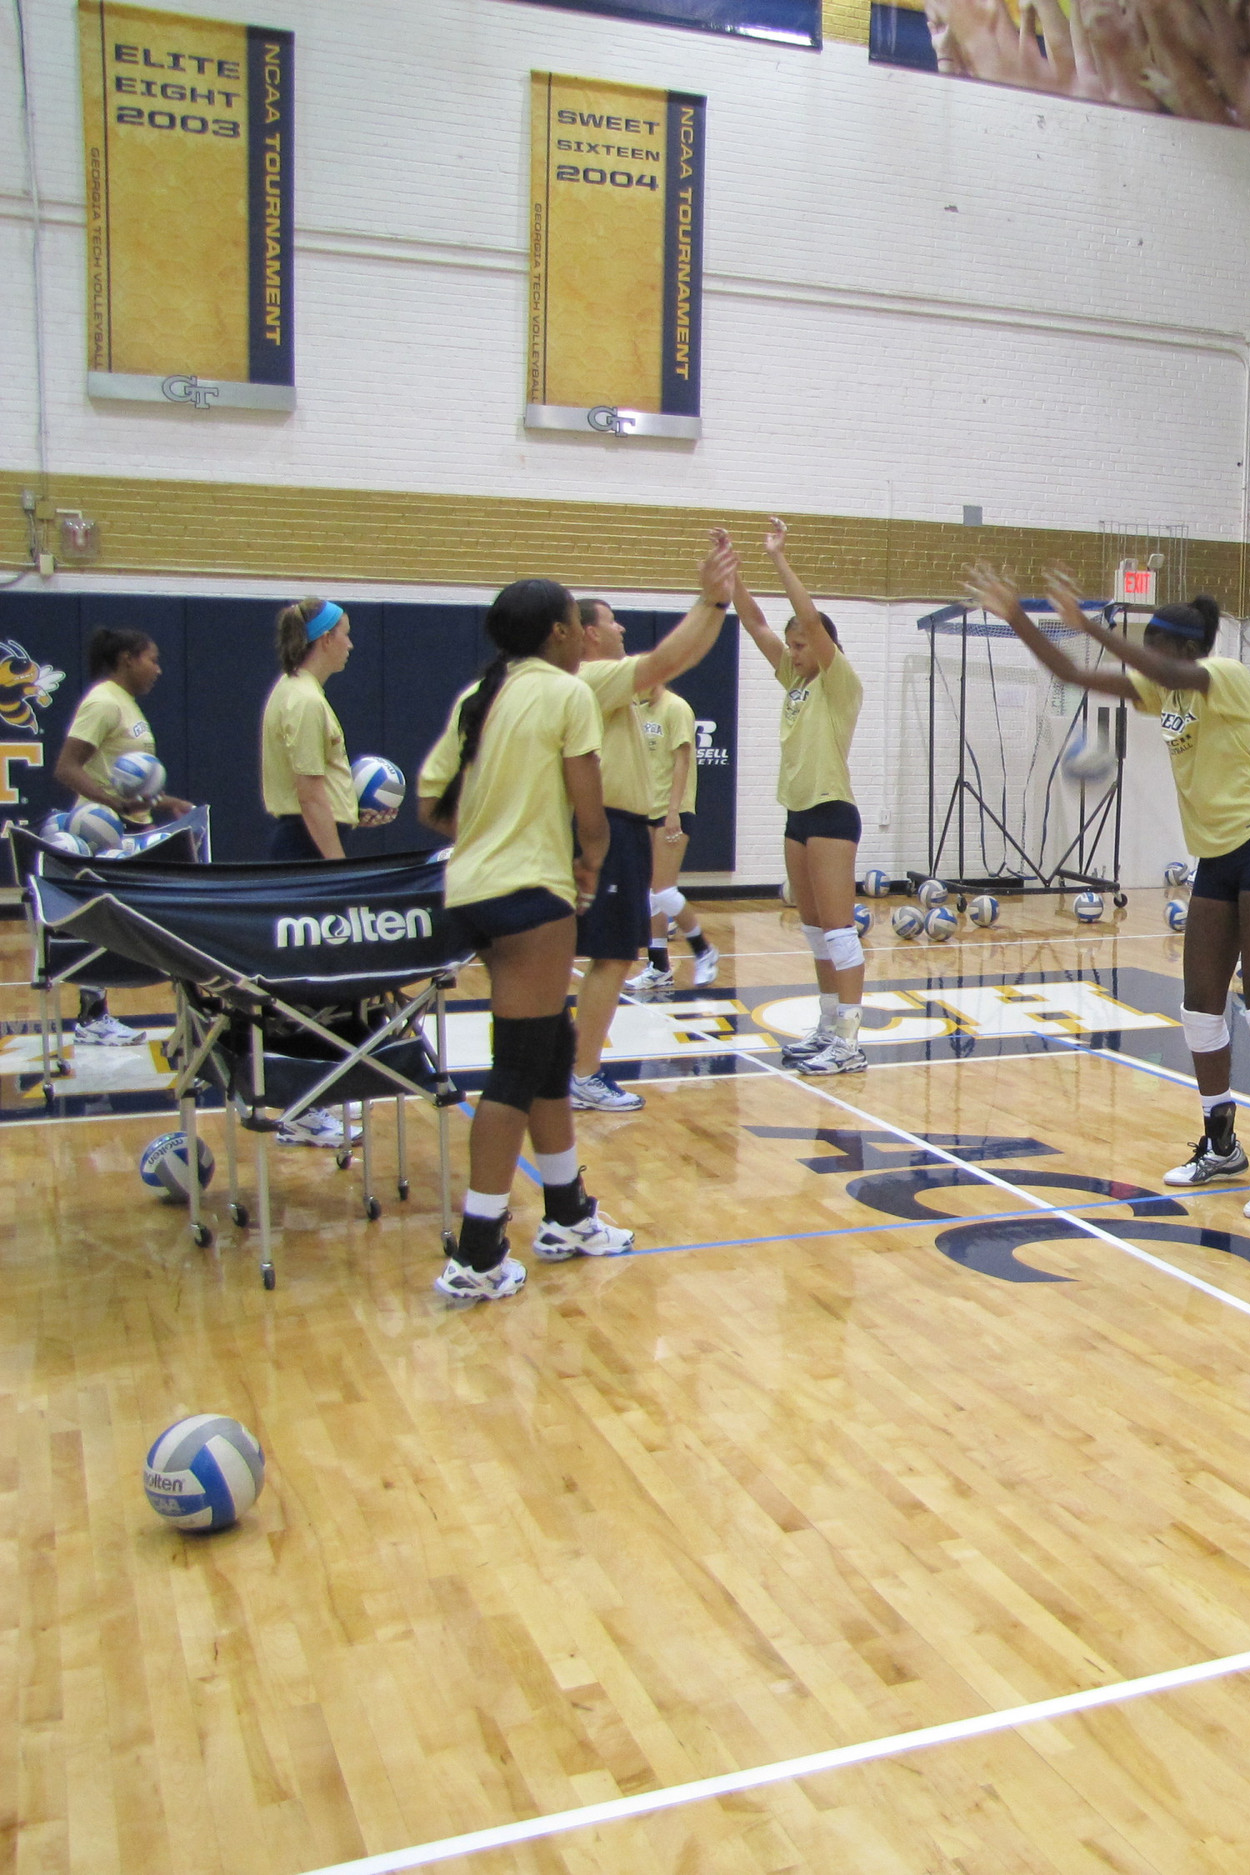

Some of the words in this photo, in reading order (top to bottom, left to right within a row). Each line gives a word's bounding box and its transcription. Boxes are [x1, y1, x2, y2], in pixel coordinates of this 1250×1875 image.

[114, 42, 240, 80] ELITE
[114, 75, 241, 108] EIGHT
[264, 43, 281, 124] NCAA
[116, 105, 241, 139] 2003
[557, 109, 660, 135] SWEET
[557, 139, 660, 162] SIXTEEN
[679, 107, 695, 179] NCAA
[90, 147, 100, 220] GEORGIA
[556, 164, 659, 191] 2004
[92, 226, 102, 268] TECH
[264, 133, 281, 345] TOURNAMENT
[533, 203, 542, 269] GEORGIA
[532, 273, 541, 311] TECH
[675, 187, 692, 381] TOURNAMENT
[92, 272, 104, 371] VOLLEYBALL
[530, 315, 540, 403] VOLLEYBALL
[1125, 571, 1152, 594] EXIT
[696, 748, 729, 759] SELL
[276, 906, 433, 948] molten
[148, 1138, 184, 1165] molten
